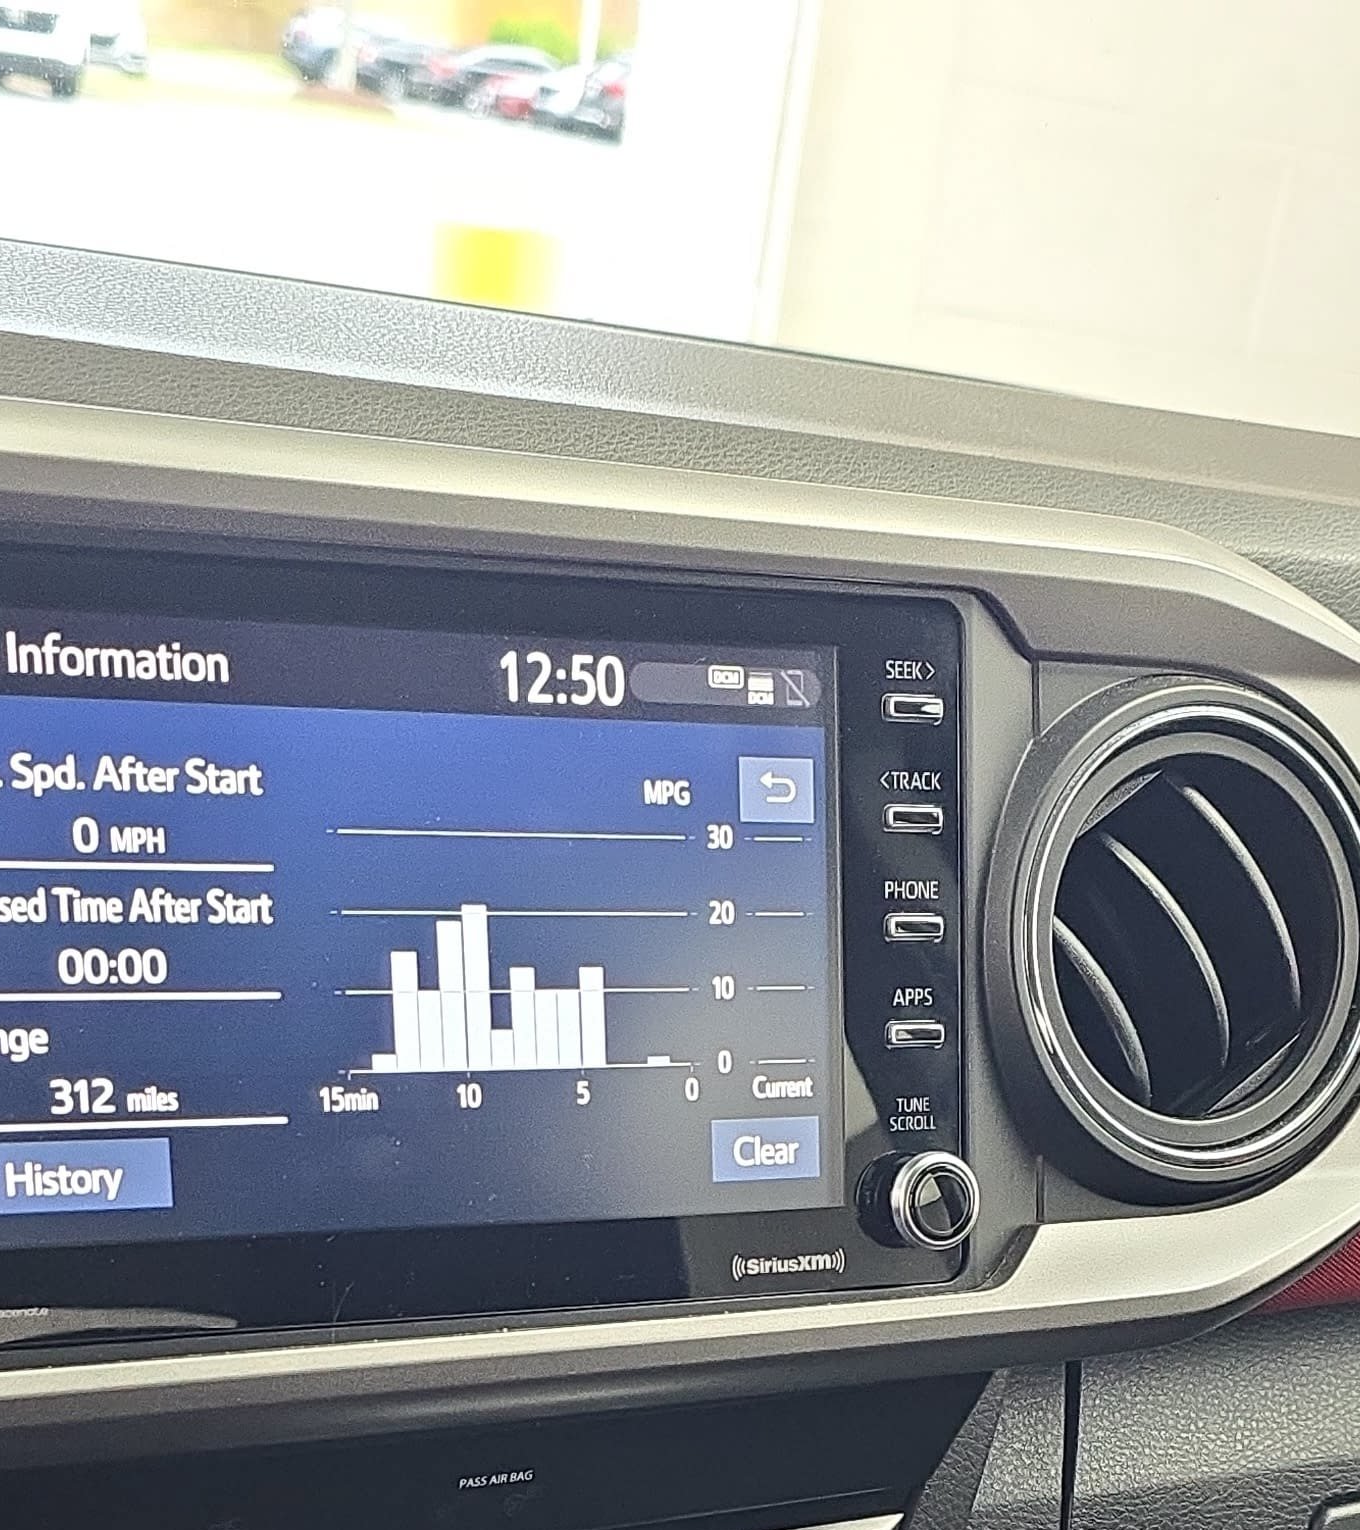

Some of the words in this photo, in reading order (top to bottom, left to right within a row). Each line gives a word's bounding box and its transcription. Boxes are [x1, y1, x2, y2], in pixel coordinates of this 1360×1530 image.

[6, 631, 230, 684] Information
[500, 650, 626, 707] 12:50
[9, 751, 86, 797] Spd.
[94, 755, 180, 795] After
[185, 758, 263, 797] Start
[643, 779, 691, 806] MPG
[73, 817, 98, 853] 0
[110, 826, 165, 854] MPH
[707, 825, 734, 850] 30
[884, 880, 939, 901] PHONE
[52, 886, 125, 923] Time
[130, 888, 201, 925] After
[206, 889, 273, 926] Start
[708, 902, 735, 926] 20
[57, 948, 168, 984] 00:00
[712, 975, 735, 1000] 10
[892, 987, 933, 1007] APPS
[717, 1050, 732, 1075] 0
[49, 1078, 116, 1115] 312
[126, 1087, 178, 1113] miles
[319, 1086, 380, 1113] 15min
[457, 1083, 482, 1109] 10
[576, 1081, 591, 1105] 5
[684, 1077, 699, 1101] 0
[752, 1075, 814, 1100] Current
[896, 1097, 930, 1114] TUNE
[889, 1114, 937, 1132] SCROLL
[732, 1135, 799, 1166] Clear
[4, 1162, 124, 1201] History
[459, 1475, 487, 1489] PASS
[489, 1473, 507, 1485] AIR
[510, 1470, 534, 1483] BAG
